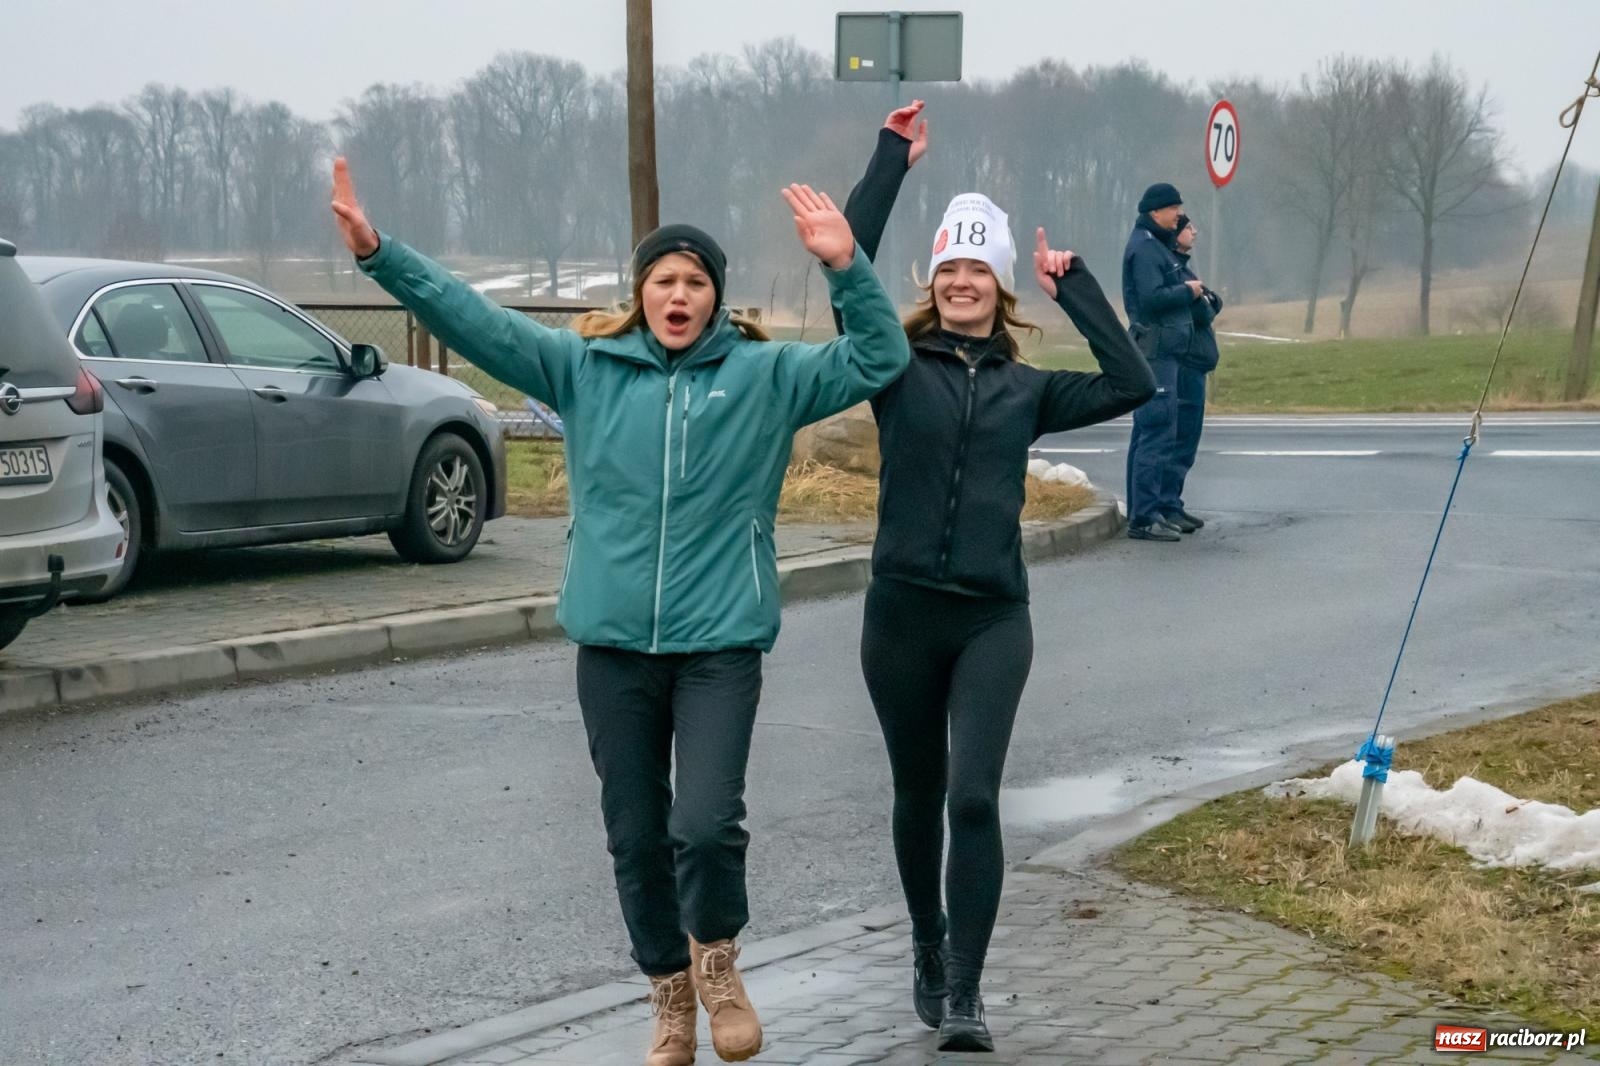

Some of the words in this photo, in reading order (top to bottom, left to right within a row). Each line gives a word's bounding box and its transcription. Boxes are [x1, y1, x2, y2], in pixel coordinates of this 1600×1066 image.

[1213, 122, 1235, 162] 70
[951, 220, 986, 246] 18
[0, 449, 48, 476] 50315
